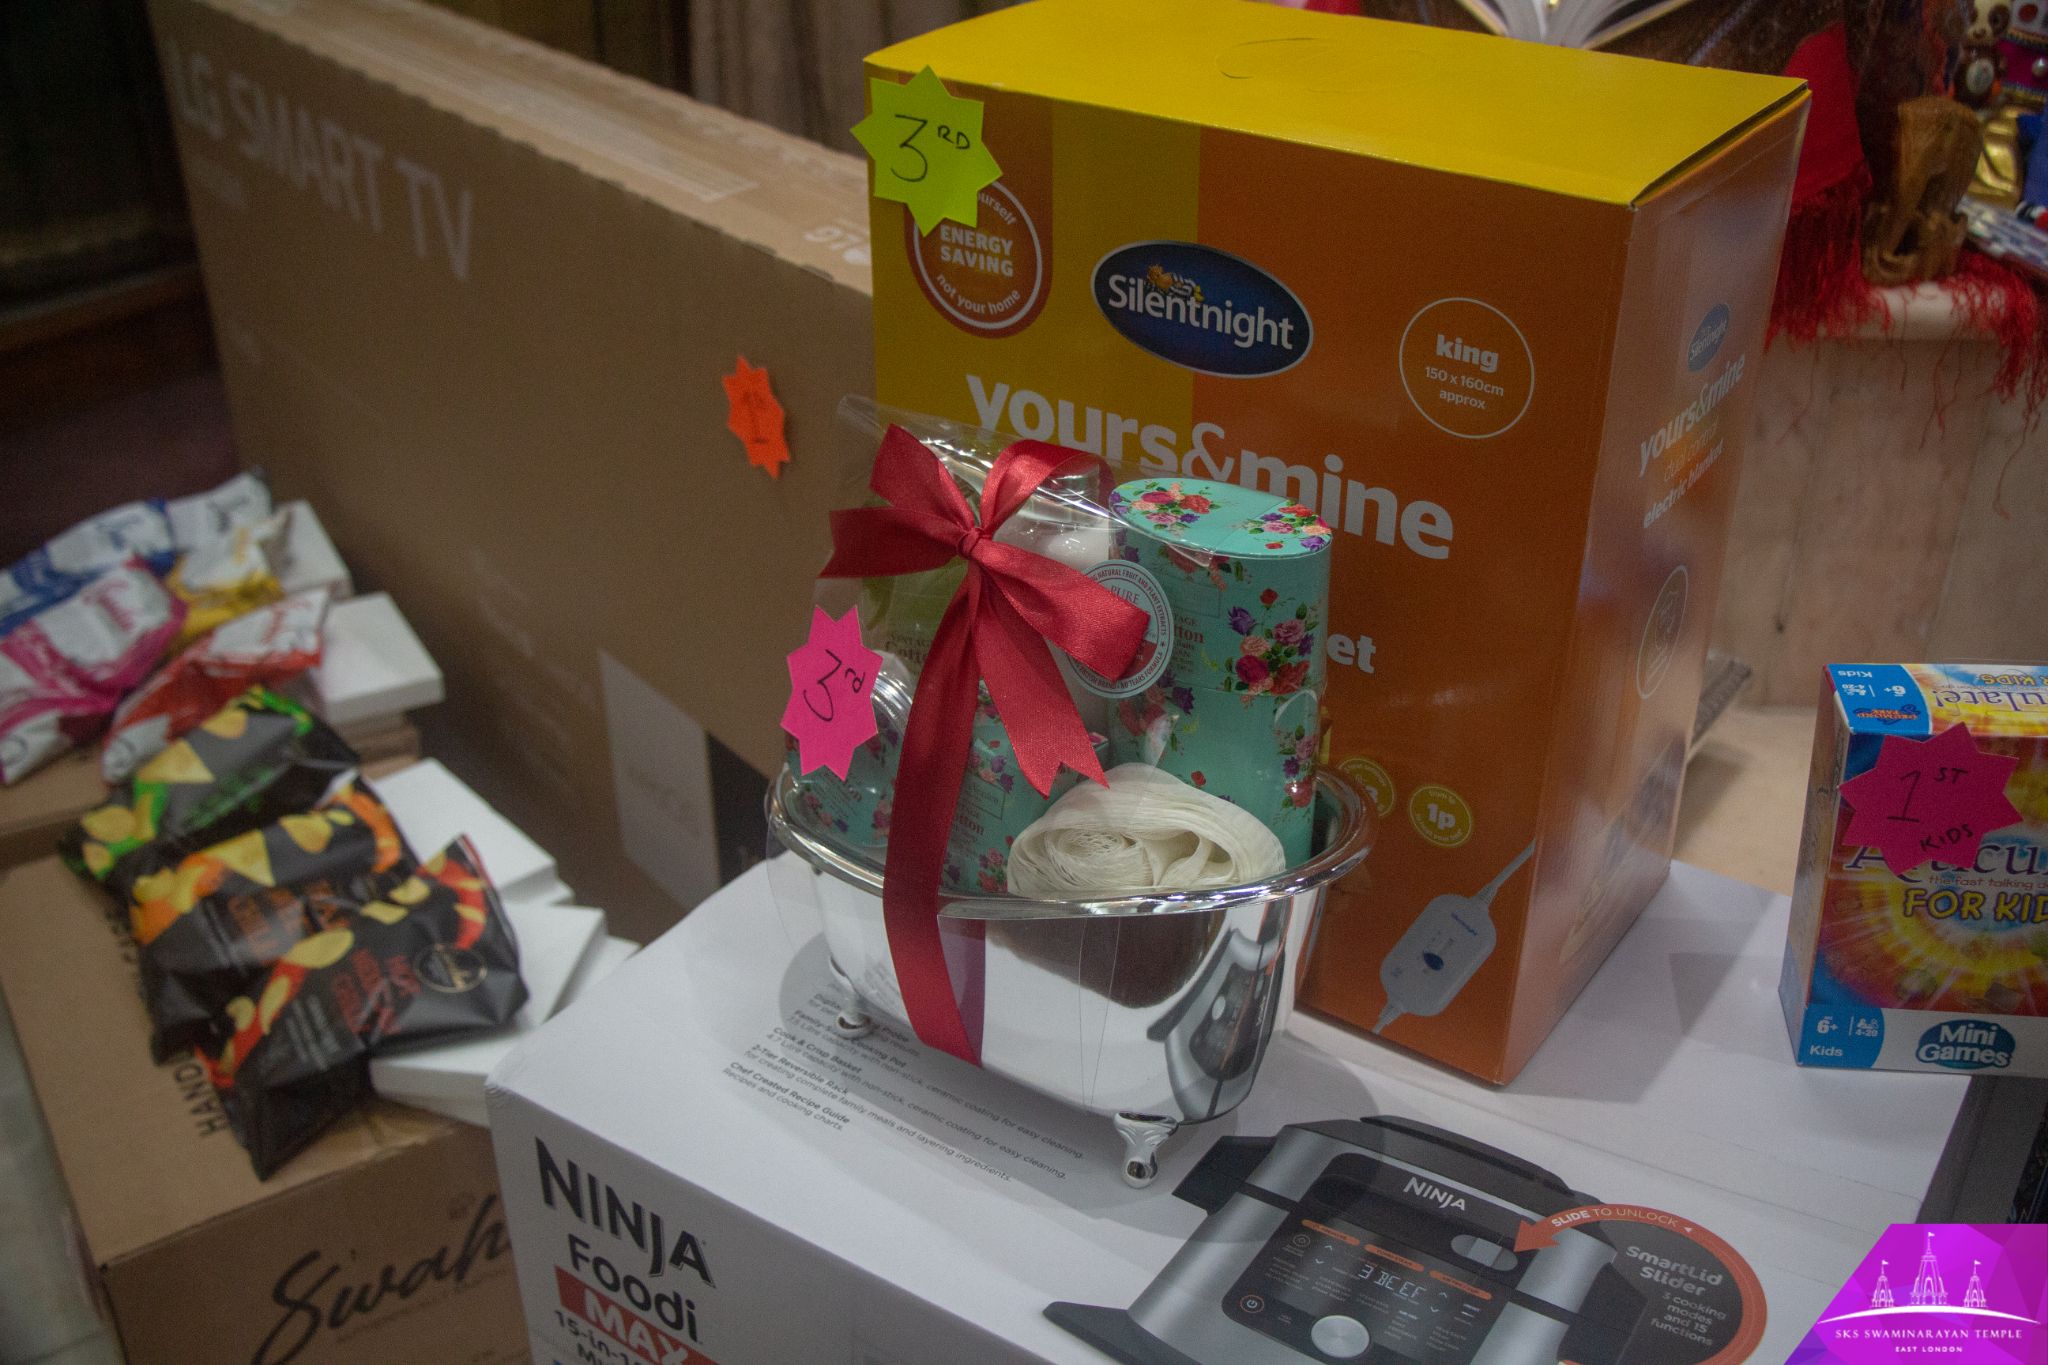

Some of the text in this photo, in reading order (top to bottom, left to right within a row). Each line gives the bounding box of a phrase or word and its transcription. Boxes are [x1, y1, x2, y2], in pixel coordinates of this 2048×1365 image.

[228, 69, 385, 234] SMART
[392, 154, 474, 280] TV
[978, 191, 1018, 226] urself
[940, 223, 1014, 257] ENERGY
[940, 244, 1015, 278] SAVING
[936, 272, 1022, 316] not your home
[1108, 273, 1295, 351] Silentnight
[1436, 333, 1499, 373] king
[1424, 366, 1505, 397] 150 x 160cm
[1439, 388, 1487, 410] approx
[1121, 568, 1140, 582] FRUIT
[1137, 576, 1150, 591] AND
[1147, 585, 1161, 606] PLANT
[1156, 603, 1168, 637] EXTRACTS
[1144, 651, 1163, 677] FORMULA
[1837, 670, 1873, 679] Kids
[1932, 690, 2047, 713] ulate!
[1427, 802, 1457, 831] 1p
[1919, 823, 1975, 852] KIDS
[1928, 875, 1952, 885] the
[1955, 876, 1984, 887] fast
[1988, 878, 2034, 891] talking
[1903, 886, 2048, 925] FOR KID
[1817, 1018, 1838, 1034] 6+
[1939, 1023, 1997, 1046] Mini
[774, 1027, 797, 1042] Cook
[806, 1043, 831, 1059] Crisp
[831, 1055, 862, 1073] Basket
[889, 1055, 907, 1069] Pot
[1809, 1044, 1844, 1057] Kids
[1918, 1042, 2009, 1067] Games
[752, 1043, 849, 1095] 2-Tier Reversible Rack
[173, 1060, 228, 1136] HAND
[723, 1067, 757, 1089] Recipes
[757, 1086, 778, 1098] and
[776, 1095, 814, 1117] cooking
[730, 1061, 850, 1125] Chef Created Recipe Guide
[821, 1034, 862, 1056] capacity
[861, 1052, 882, 1065] with
[926, 1084, 963, 1104] ceramic
[964, 1100, 1001, 1122] coating
[1001, 1117, 1018, 1129] for
[1017, 1124, 1041, 1140] easy
[1041, 1134, 1085, 1160] cleaning.
[758, 1057, 796, 1080] creating
[795, 1076, 839, 1100] complete
[838, 1096, 869, 1115] family
[868, 1110, 897, 1128] meals
[896, 1124, 917, 1138] and
[917, 1133, 955, 1156] layering
[955, 1152, 1012, 1182] ingredients.
[801, 1051, 840, 1073] capacity
[840, 1069, 862, 1083] with
[907, 1102, 945, 1124] ceramic
[945, 1120, 983, 1141] coating
[983, 1136, 1001, 1148] for
[999, 1144, 1024, 1160] easy
[1023, 1154, 1067, 1180] cleaning.
[1401, 1176, 1467, 1213] NINJA
[535, 1135, 716, 1290] NINJA
[1551, 1207, 1679, 1228] SLIDE TO UNLOCK
[251, 1193, 512, 1365] Swah
[1624, 1245, 1724, 1289] SmartLid
[1639, 1266, 1707, 1298] Slider
[1663, 1312, 1709, 1335] and 15
[1666, 1302, 1714, 1327] modes
[1671, 1294, 1727, 1322] cooking
[583, 1287, 690, 1365] MAX
[1649, 1317, 1715, 1348] functions
